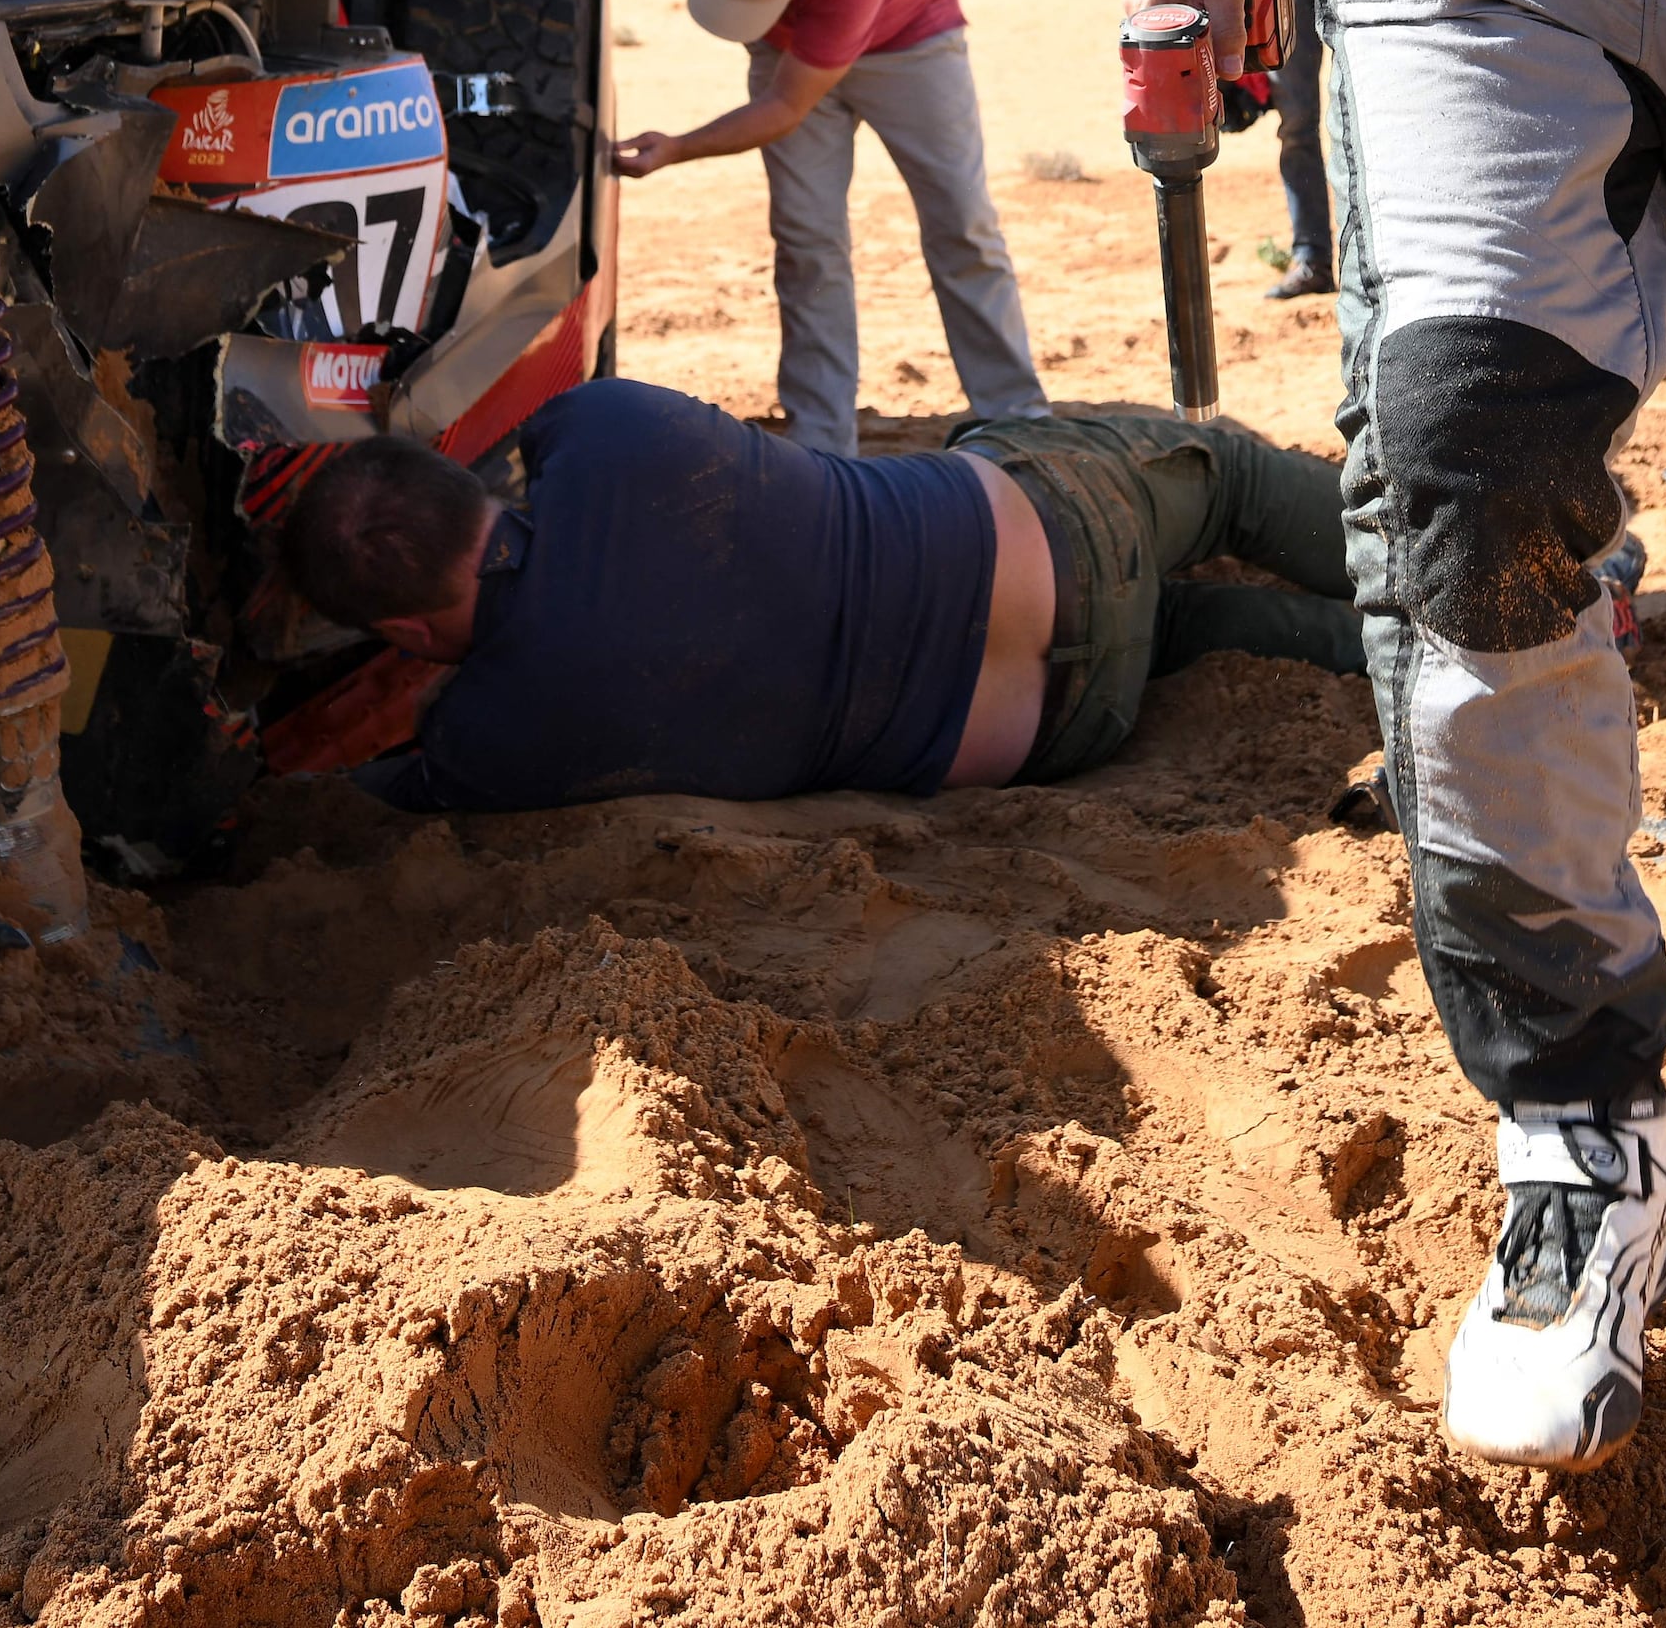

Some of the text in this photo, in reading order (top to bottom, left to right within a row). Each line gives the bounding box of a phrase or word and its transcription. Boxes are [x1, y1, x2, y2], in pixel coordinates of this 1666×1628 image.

[1198, 46, 1219, 113] Milwaukee
[285, 95, 433, 144] aramco
[182, 128, 235, 153] DAKAR
[188, 152, 226, 165] 2023
[311, 352, 382, 390] MOTU
